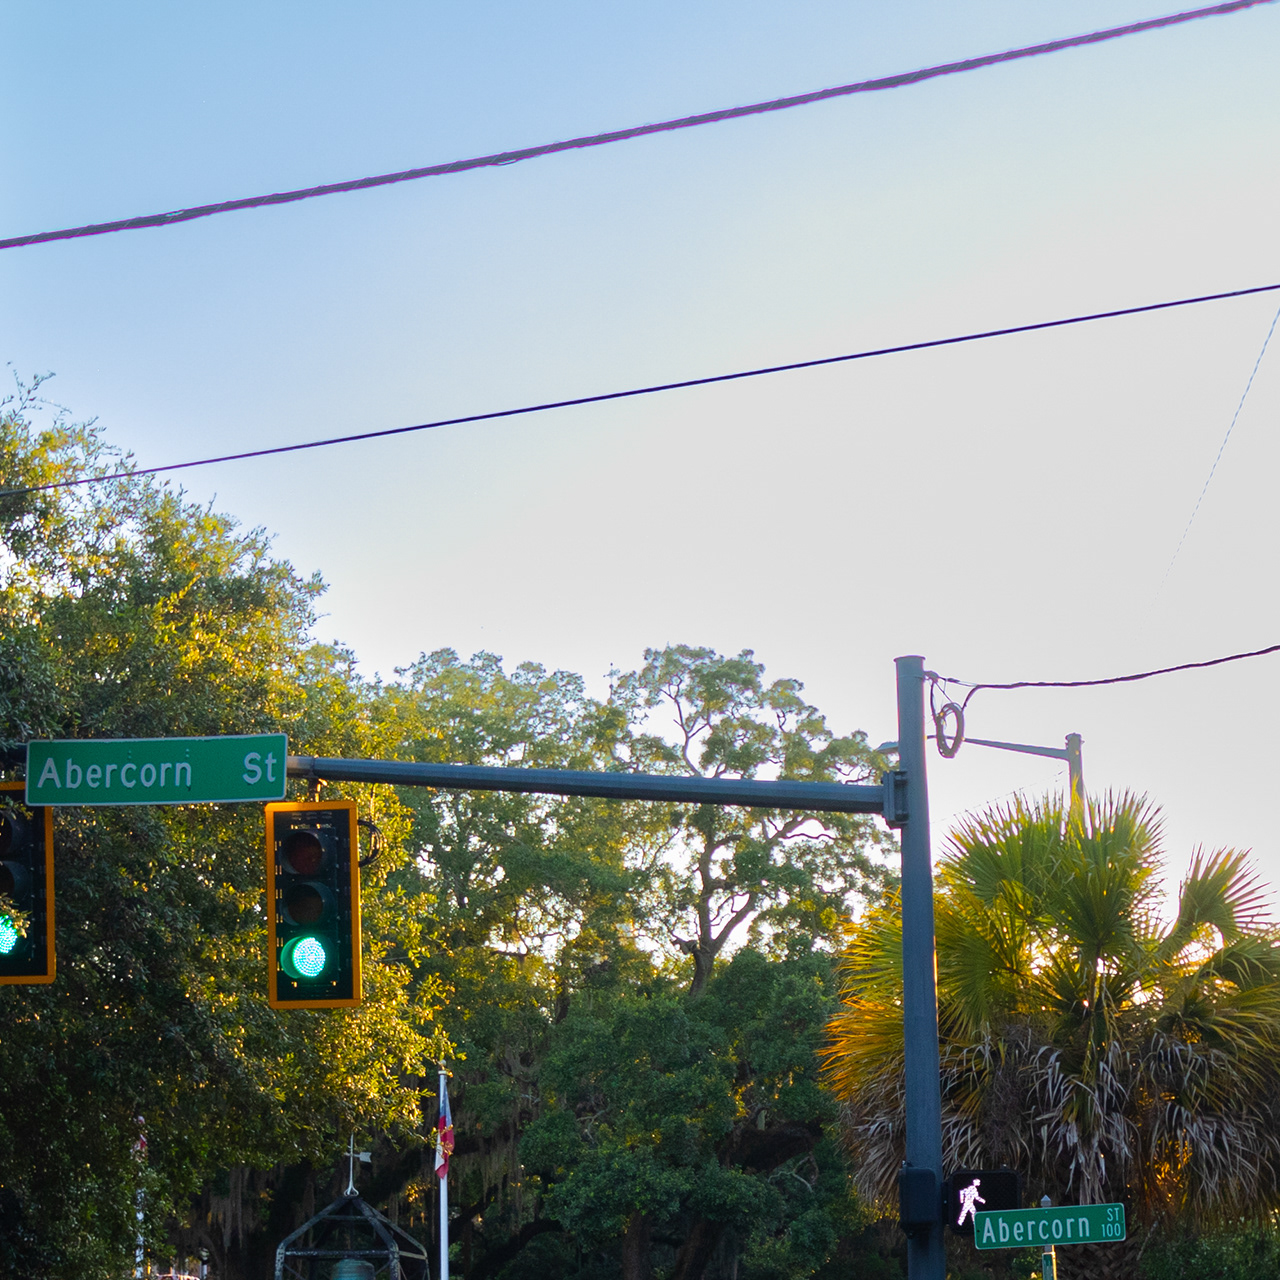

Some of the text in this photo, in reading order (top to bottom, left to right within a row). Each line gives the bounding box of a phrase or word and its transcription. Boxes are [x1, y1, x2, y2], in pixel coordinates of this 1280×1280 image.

[36, 751, 277, 790] Abercorn St
[982, 1207, 1120, 1244] Abercorn ST
[1101, 1222, 1121, 1238] 100
